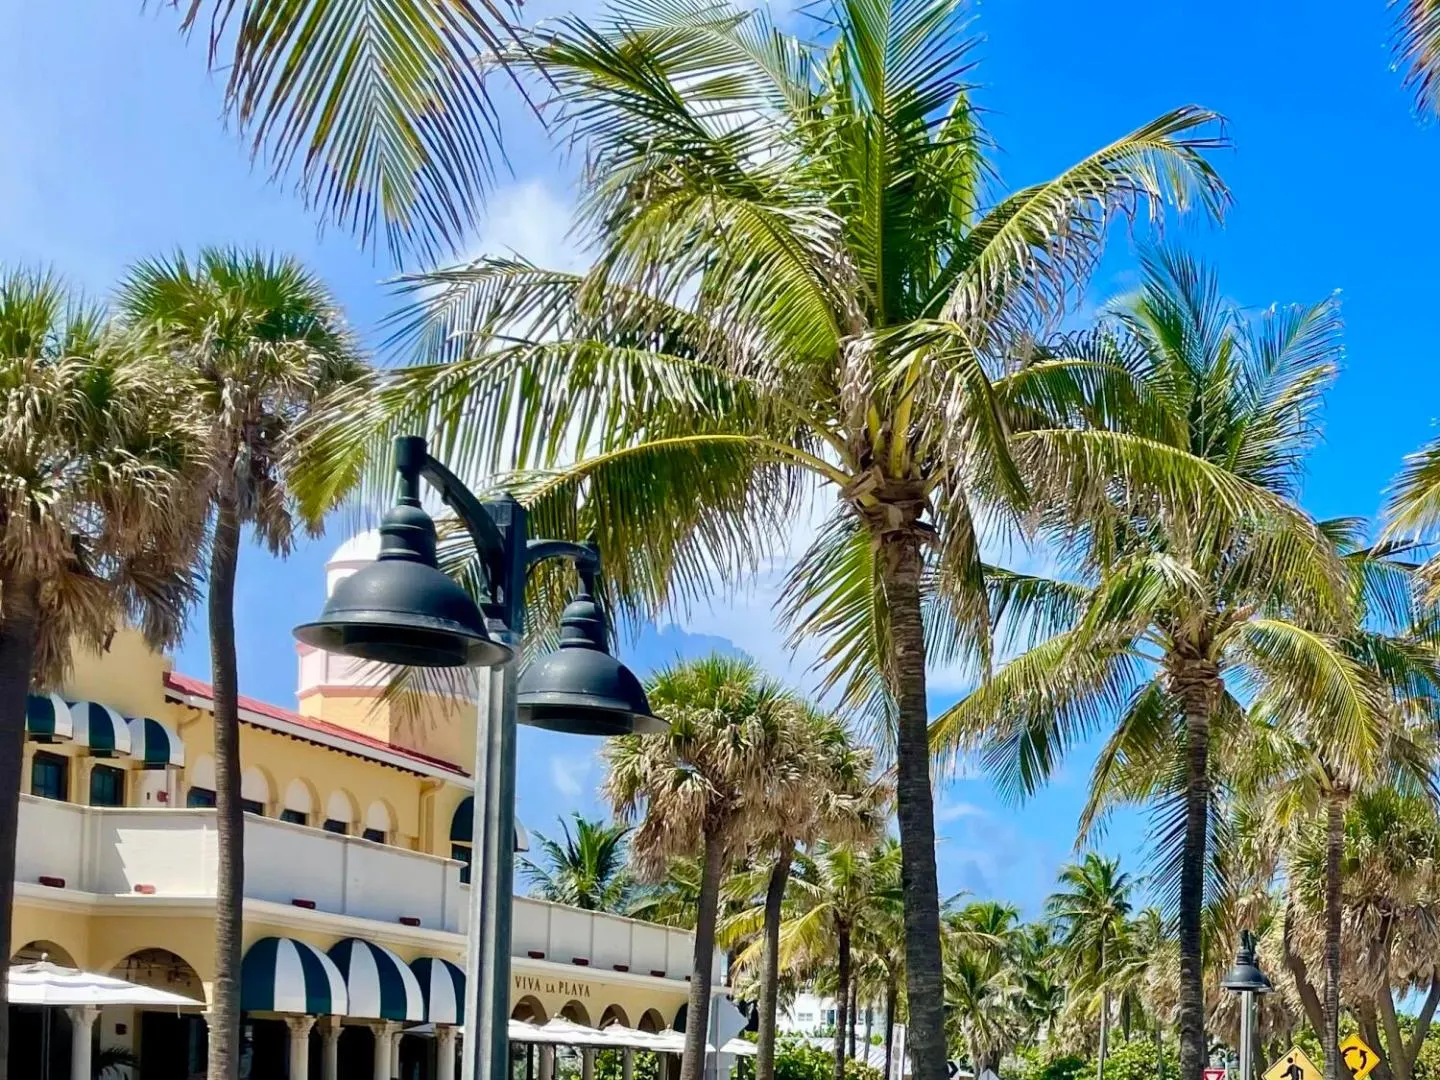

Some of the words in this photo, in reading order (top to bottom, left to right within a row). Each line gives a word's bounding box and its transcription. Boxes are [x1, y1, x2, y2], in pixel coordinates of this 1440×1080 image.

[515, 976, 540, 991] VIVA
[546, 984, 555, 993] LA
[559, 981, 590, 997] PLAYA
